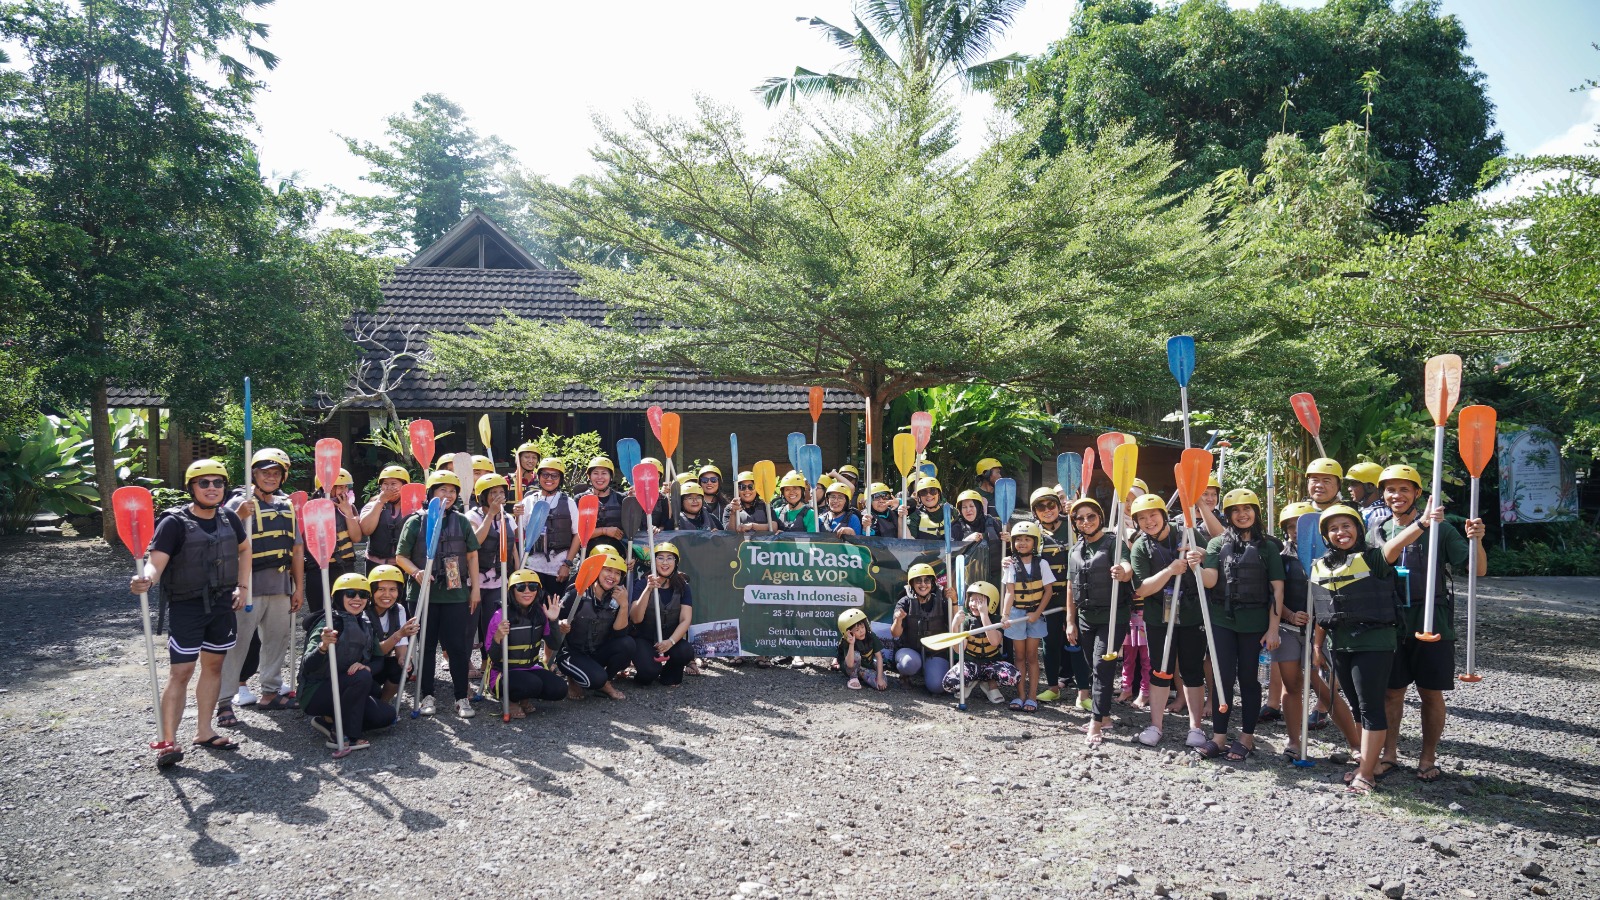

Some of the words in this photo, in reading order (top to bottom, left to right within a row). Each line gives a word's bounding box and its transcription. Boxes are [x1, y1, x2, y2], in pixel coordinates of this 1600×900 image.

[746, 545, 805, 567] Temu
[808, 547, 864, 570] Rasa
[761, 568, 799, 585] Agen
[801, 569, 814, 582] &
[815, 569, 849, 583] VOP
[751, 589, 795, 601] Varash
[797, 590, 858, 603] Indonesia
[772, 609, 794, 617] 25-27
[795, 610, 814, 619] April
[814, 610, 835, 618] 2026
[768, 626, 811, 636] Sentuhan
[812, 627, 838, 637] Cinta
[755, 639, 777, 648] yang
[778, 639, 839, 648] Menyembuhk
